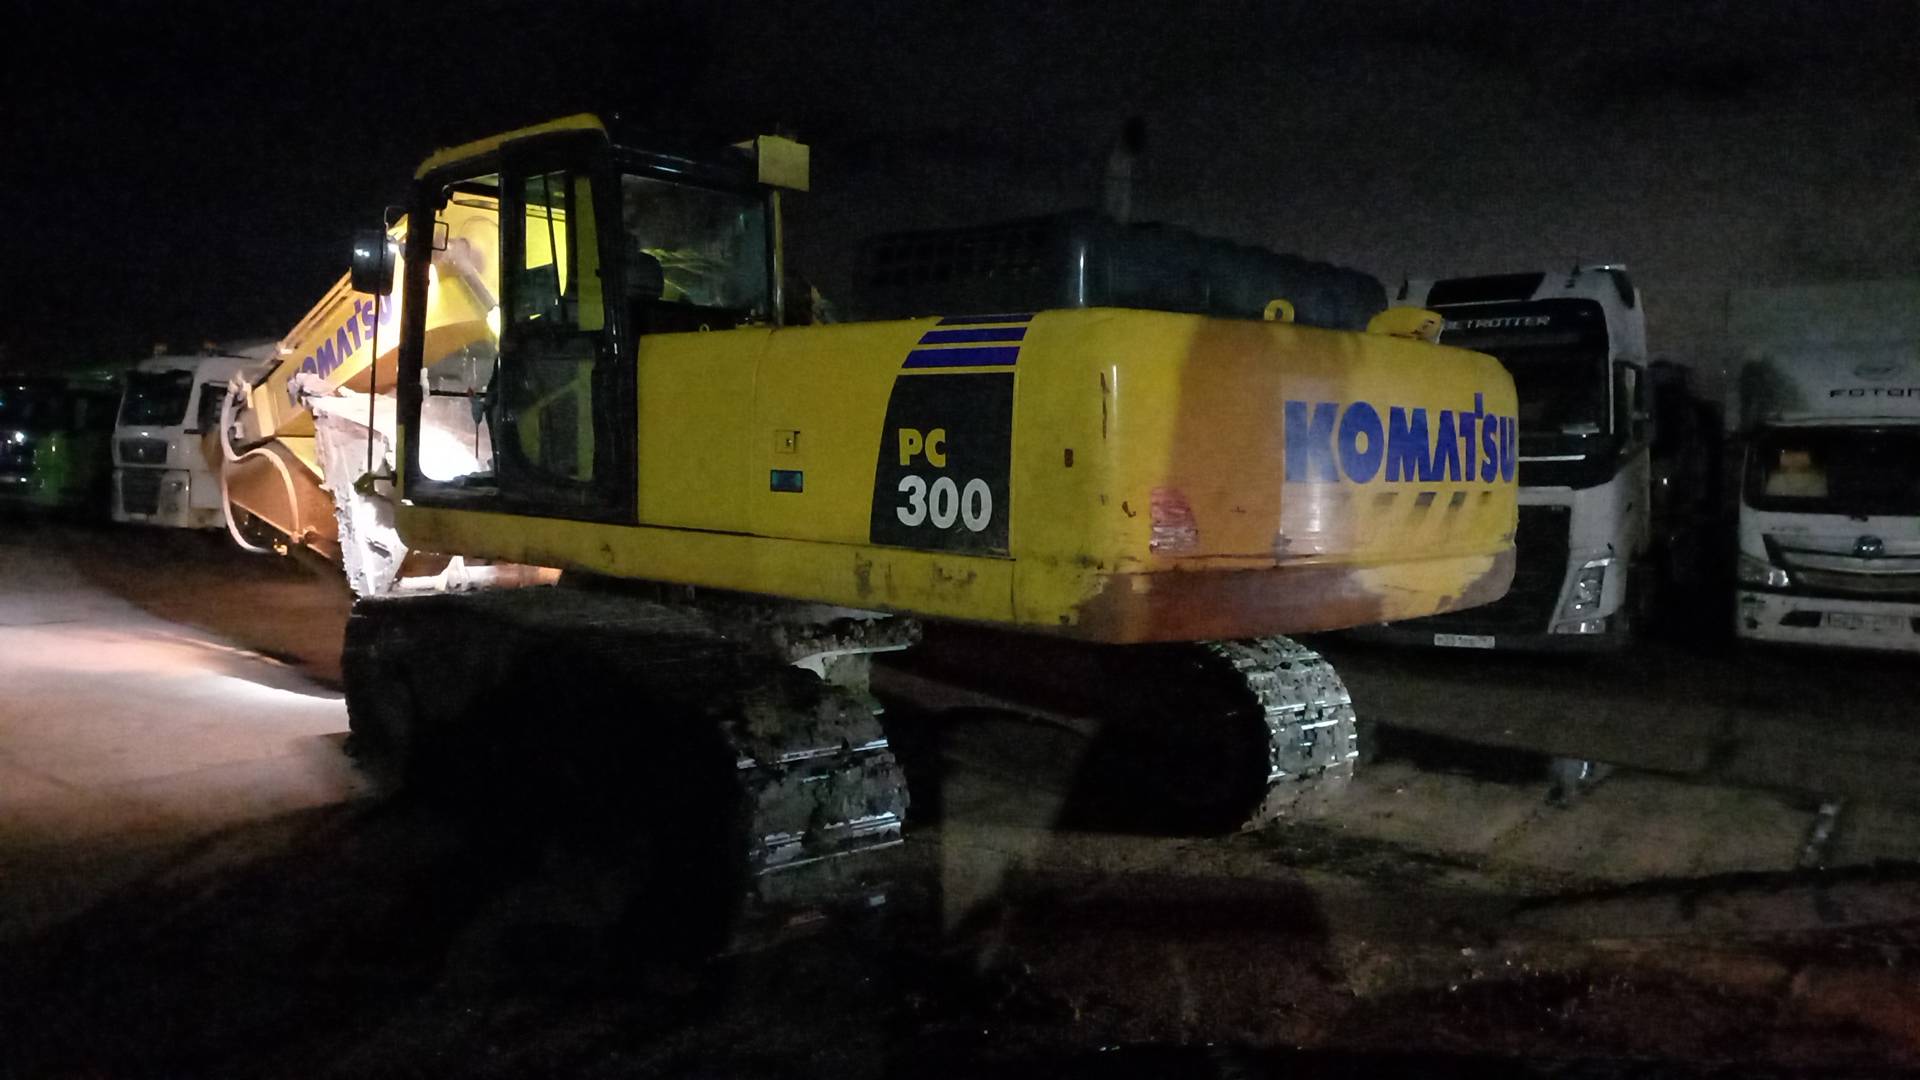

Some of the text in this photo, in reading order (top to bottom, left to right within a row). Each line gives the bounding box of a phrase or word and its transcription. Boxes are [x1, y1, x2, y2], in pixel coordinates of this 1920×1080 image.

[898, 428, 946, 468] PC
[1285, 392, 1515, 484] KOMATSU
[897, 475, 992, 532] 300
